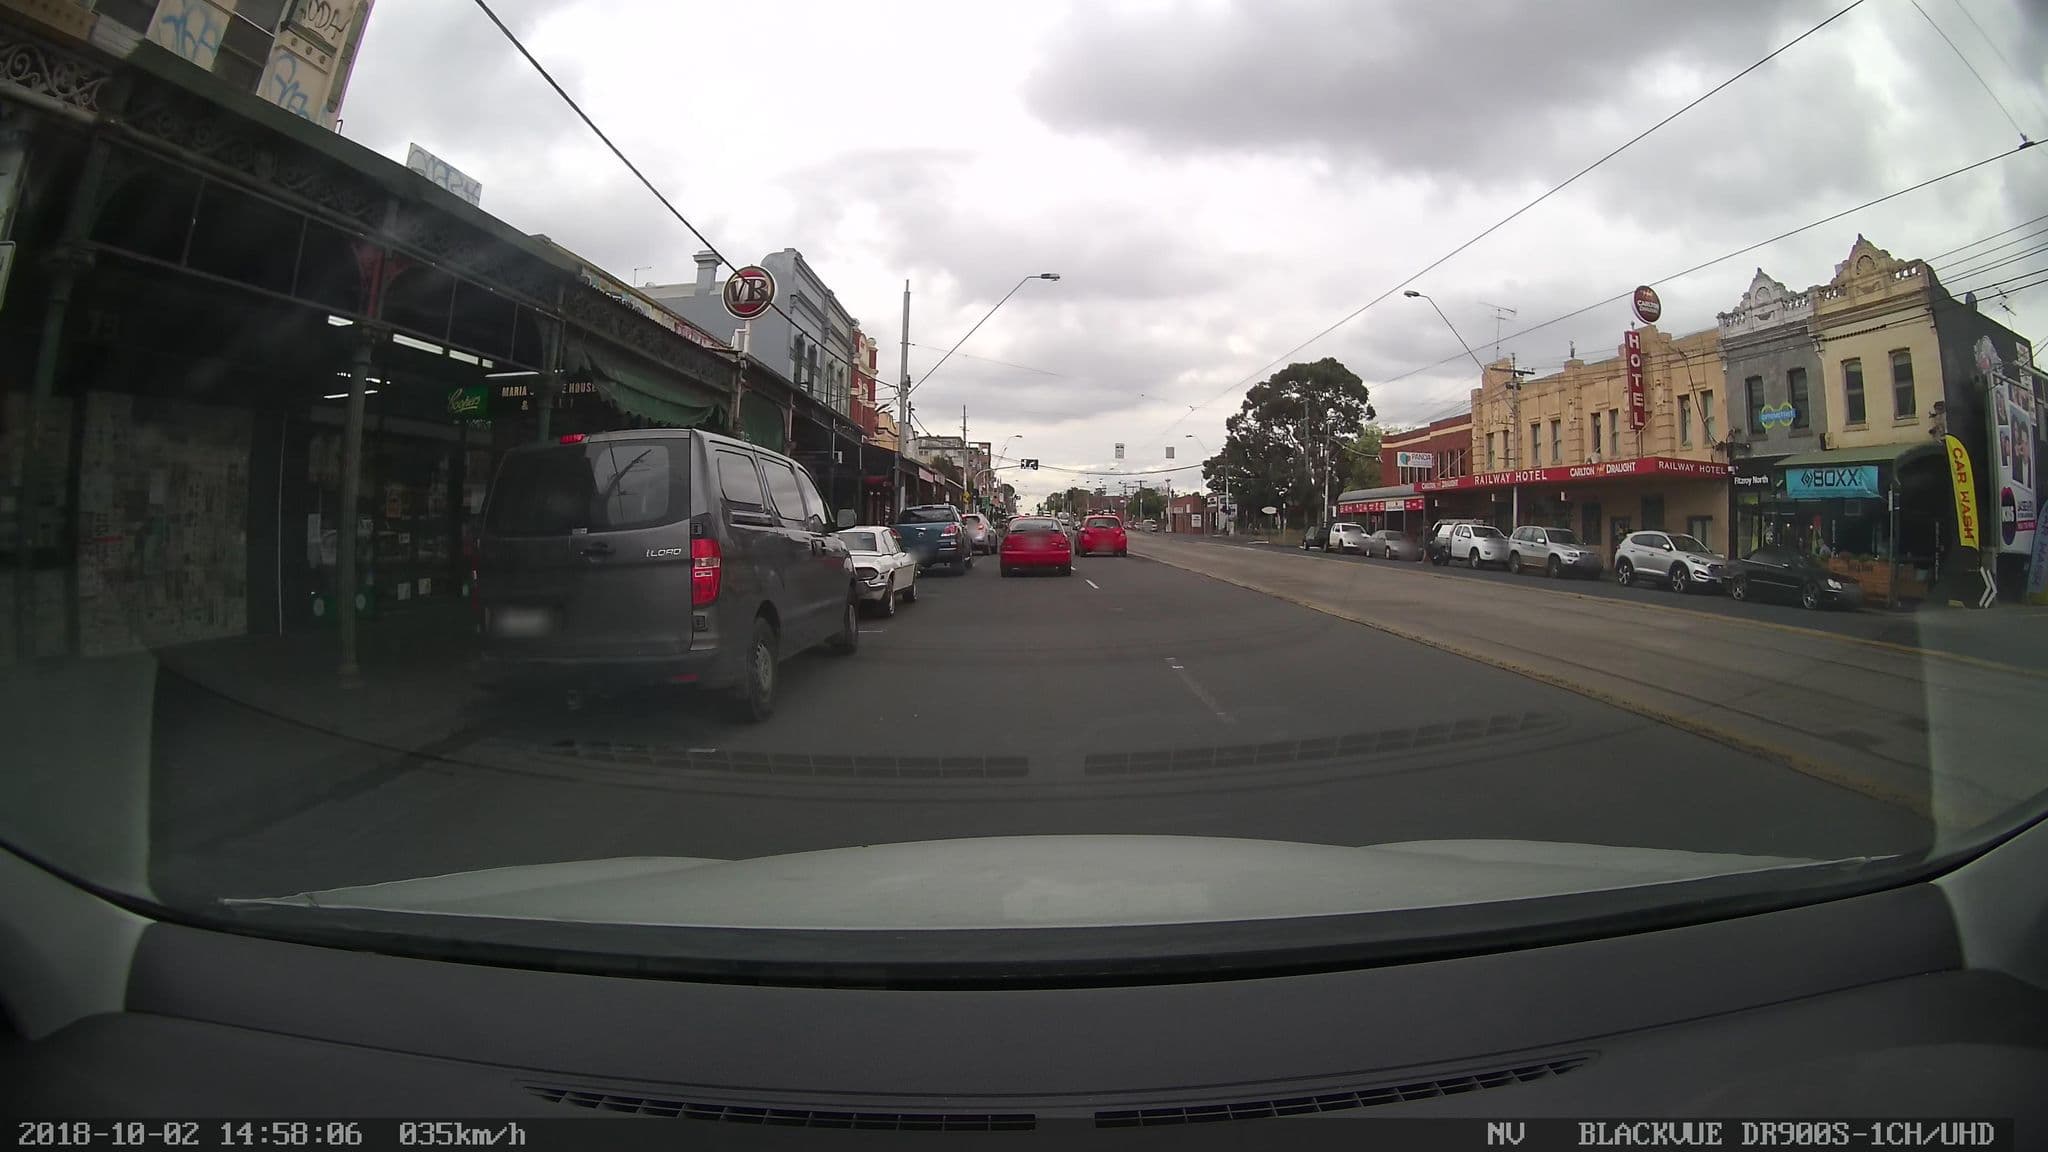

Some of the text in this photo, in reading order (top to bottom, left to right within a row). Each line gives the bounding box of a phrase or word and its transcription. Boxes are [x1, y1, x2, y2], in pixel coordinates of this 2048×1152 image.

[727, 278, 770, 303] VB
[1628, 334, 1644, 426] HOTEL
[502, 386, 528, 397] MARIA
[1569, 462, 1636, 478] CARLTON DRAUGHT
[1658, 461, 1726, 475] RAILWAY HOTEL
[1474, 470, 1547, 486] RAILWAY HOTEL
[1752, 475, 1769, 484] North
[1813, 469, 1858, 487] BOXX
[1952, 447, 1974, 539] CAR WASH
